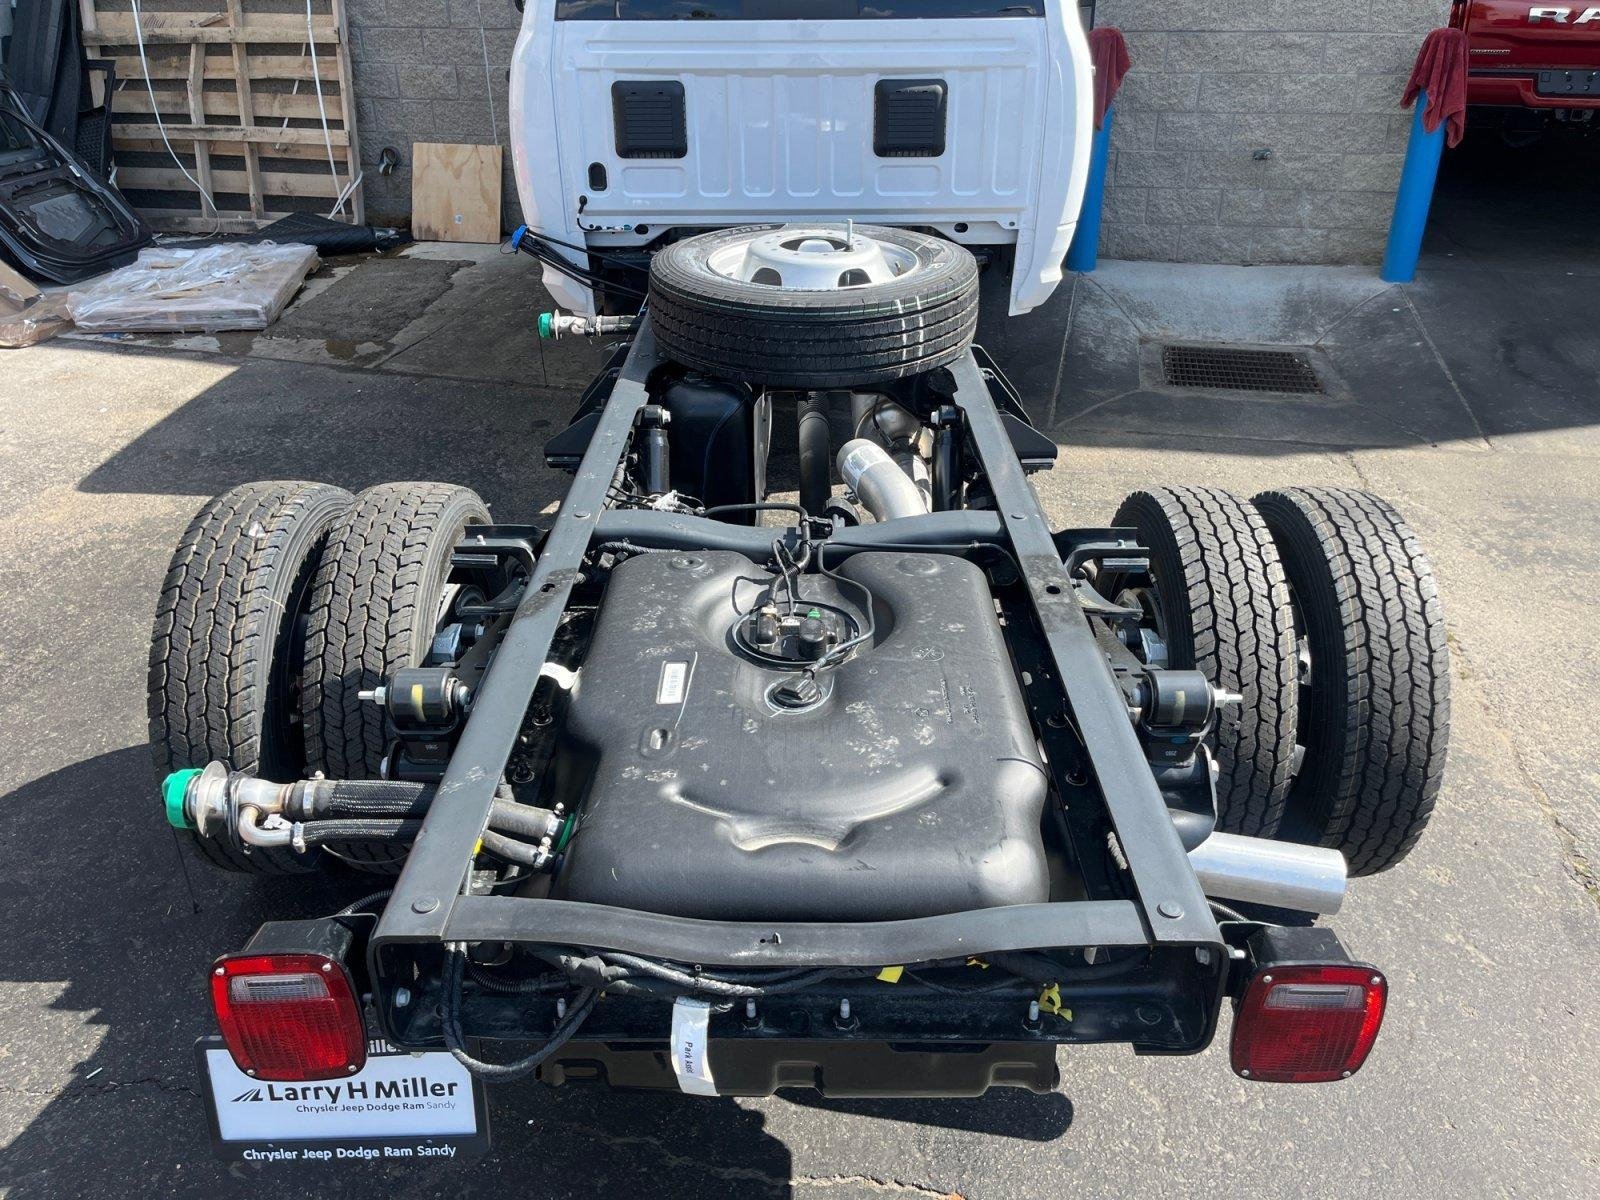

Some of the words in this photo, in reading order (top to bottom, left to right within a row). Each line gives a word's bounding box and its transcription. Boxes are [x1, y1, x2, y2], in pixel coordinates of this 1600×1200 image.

[367, 1039, 402, 1054] ille
[684, 1041, 693, 1058] Park
[267, 1083, 341, 1104] Larry
[347, 1081, 368, 1099] H
[375, 1077, 458, 1099] Miller
[296, 1104, 339, 1114] Chrysler
[341, 1104, 364, 1113] Jeep
[367, 1103, 400, 1112] Dodge
[402, 1102, 425, 1110] Ram
[426, 1101, 456, 1111] Sandy
[243, 1148, 298, 1162] Chrysler
[302, 1149, 333, 1161] Jeep
[336, 1146, 380, 1159] Dodge
[384, 1146, 413, 1157] Ram
[416, 1144, 457, 1157] Sandy
